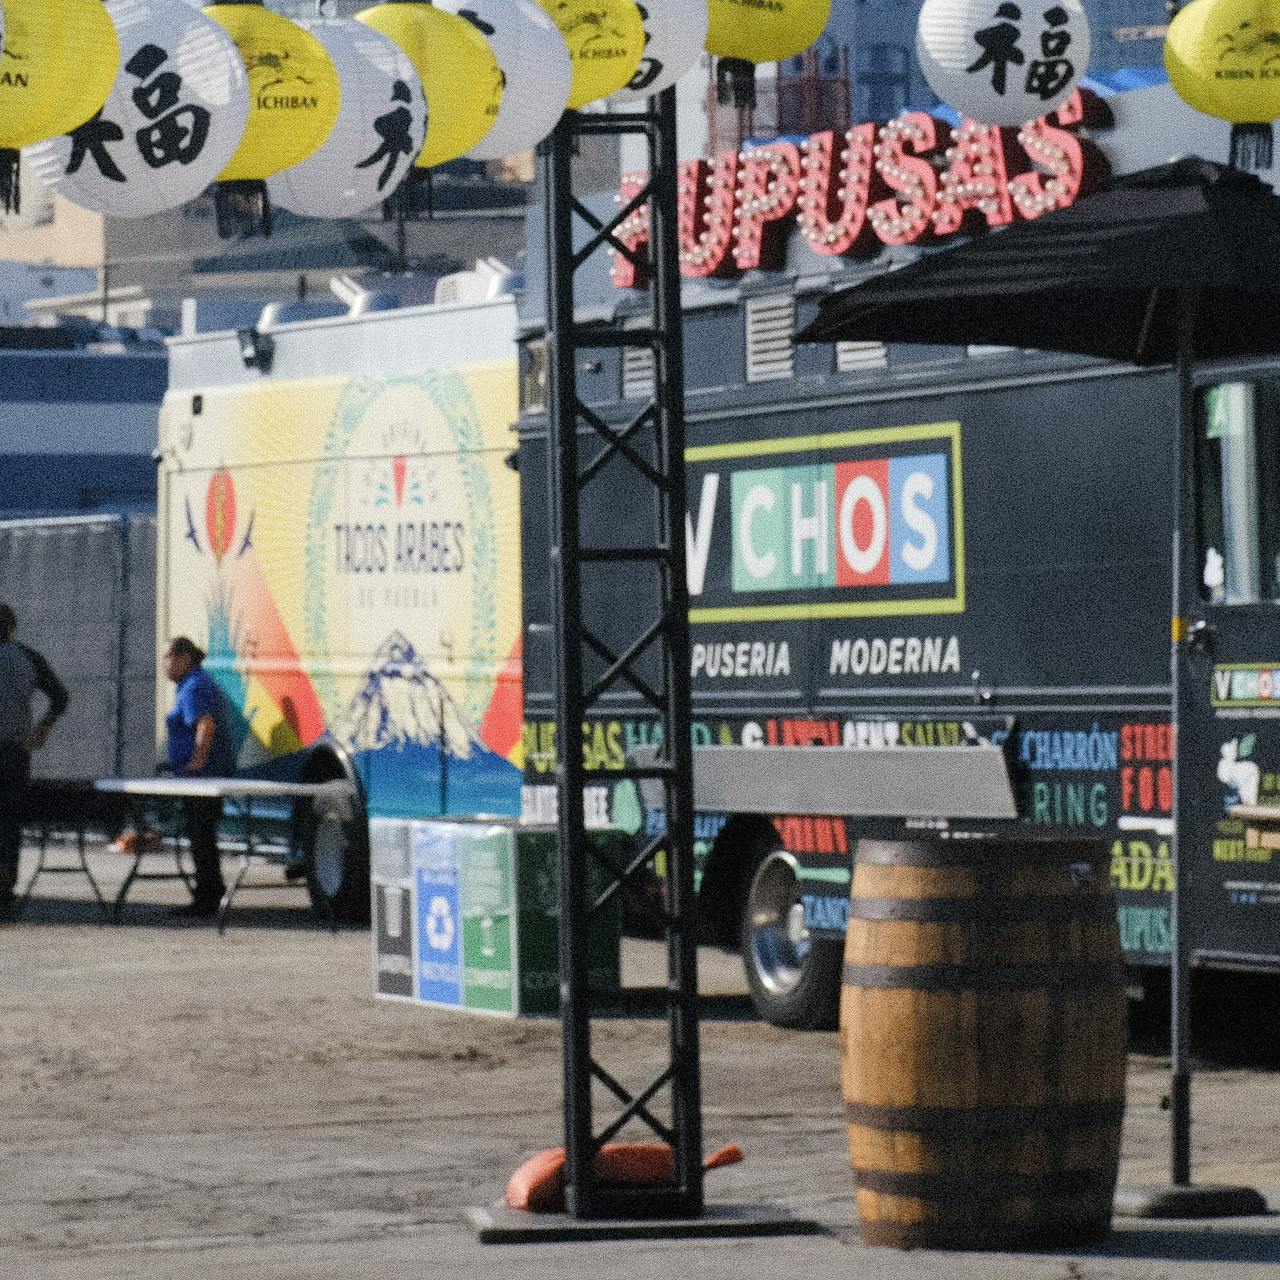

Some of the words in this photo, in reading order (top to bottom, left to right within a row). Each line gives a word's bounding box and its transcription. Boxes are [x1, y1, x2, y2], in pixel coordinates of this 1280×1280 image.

[256, 95, 320, 112] ICHIBAN
[335, 522, 388, 574] TACOS
[396, 520, 465, 572] ARABES
[691, 642, 791, 678] PUSERIA
[830, 637, 960, 675] MODERNA
[1032, 783, 1108, 827] RING
[1122, 767, 1174, 813] FOO
[1110, 840, 1175, 892] ADA
